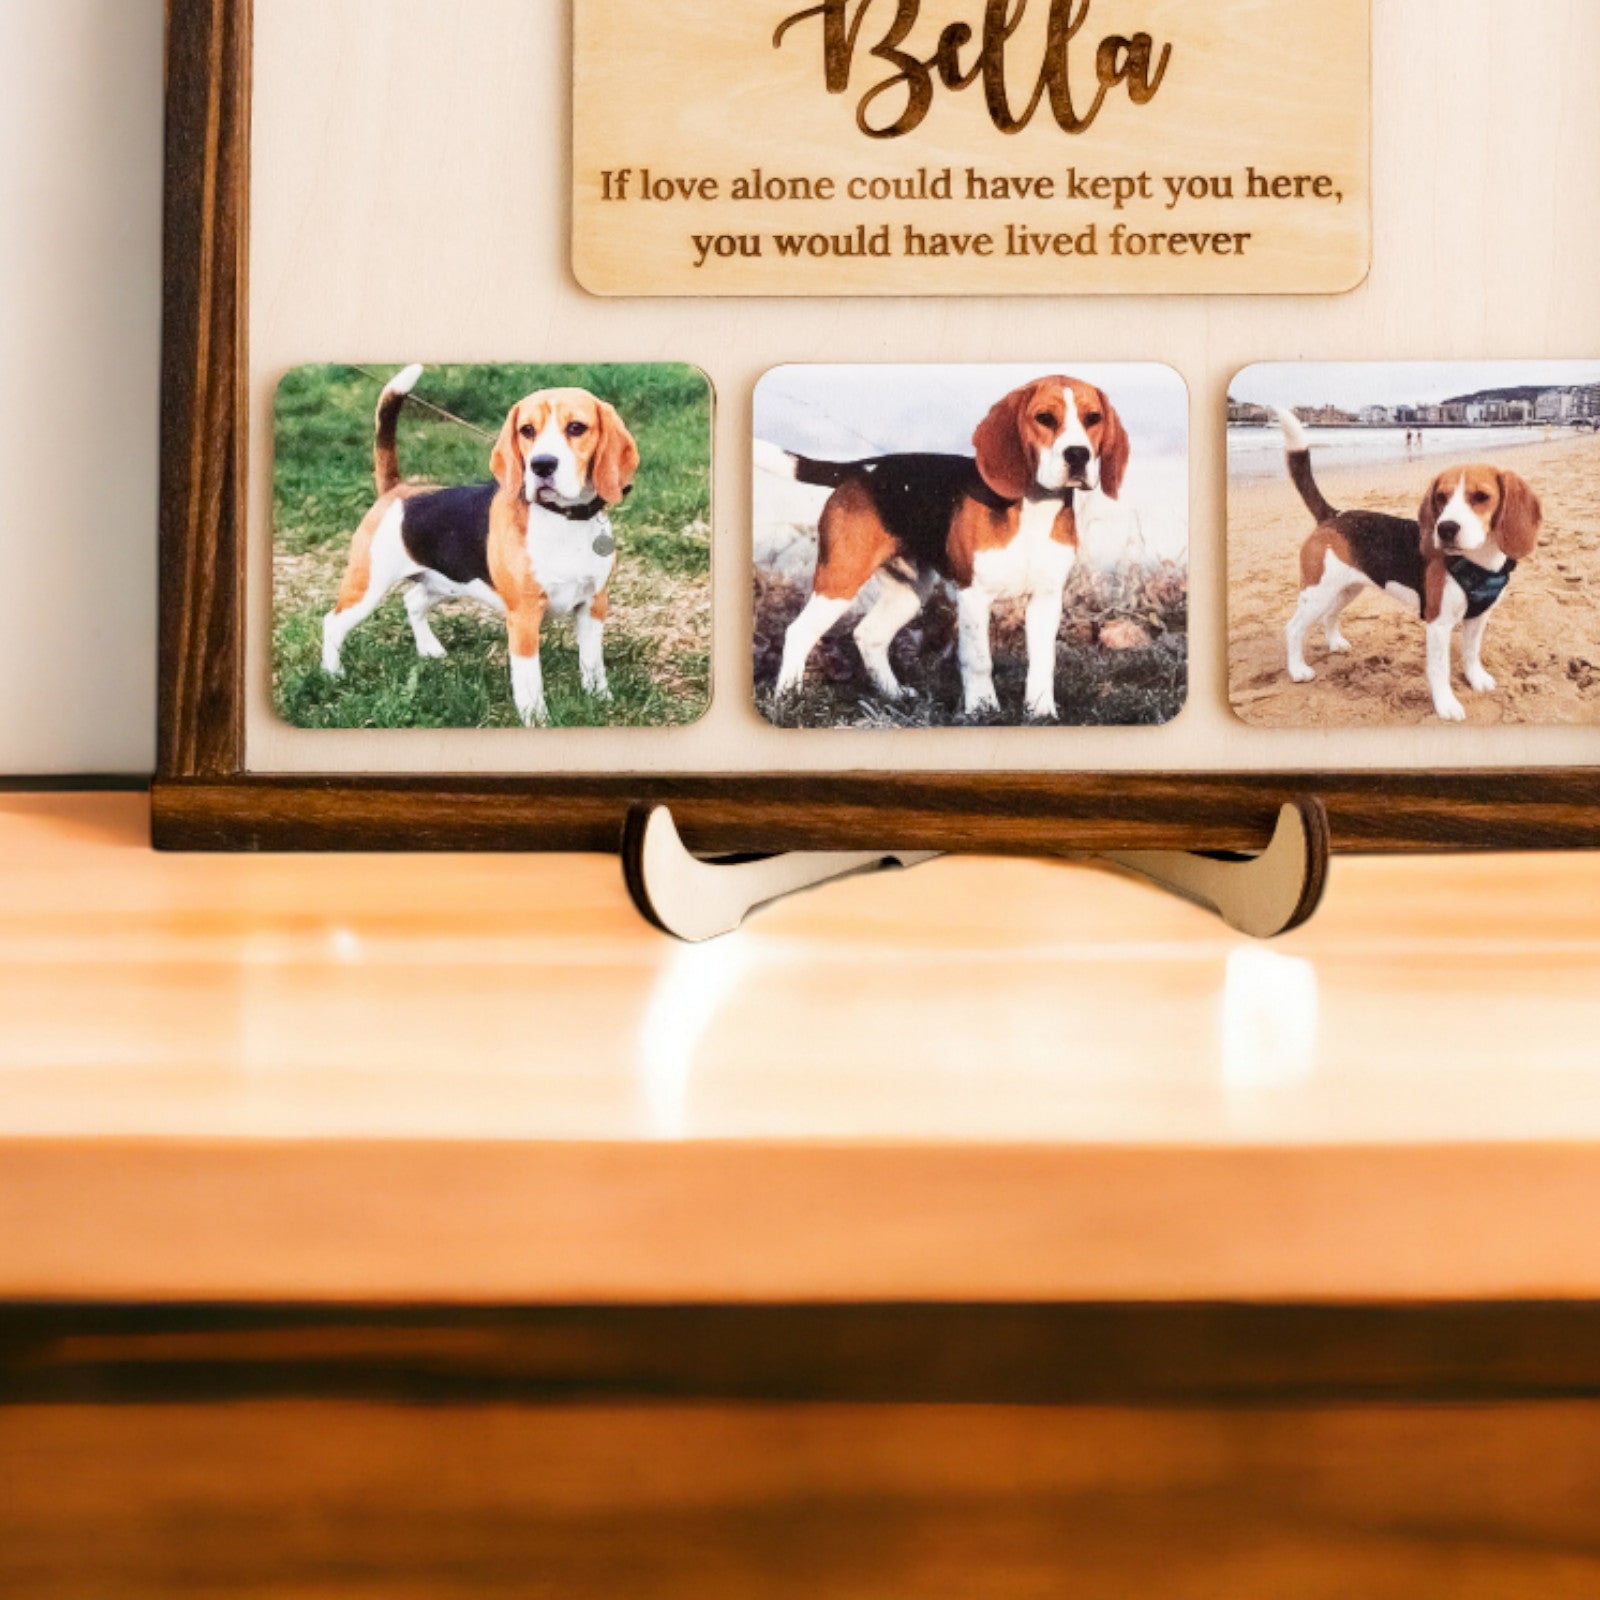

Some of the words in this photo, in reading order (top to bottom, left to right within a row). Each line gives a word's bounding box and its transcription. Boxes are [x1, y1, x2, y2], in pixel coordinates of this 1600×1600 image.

[601, 168, 631, 201] If
[640, 168, 719, 201] love
[731, 168, 834, 200] alone
[848, 168, 952, 199] could
[965, 168, 1054, 199] have
[1067, 167, 1152, 209] kept
[1163, 176, 1233, 209] you
[1246, 167, 1343, 203] here,
[691, 235, 762, 268] you
[772, 225, 891, 257] would
[904, 225, 993, 256] have
[1006, 224, 1098, 256] lived
[1109, 224, 1251, 255] forever
